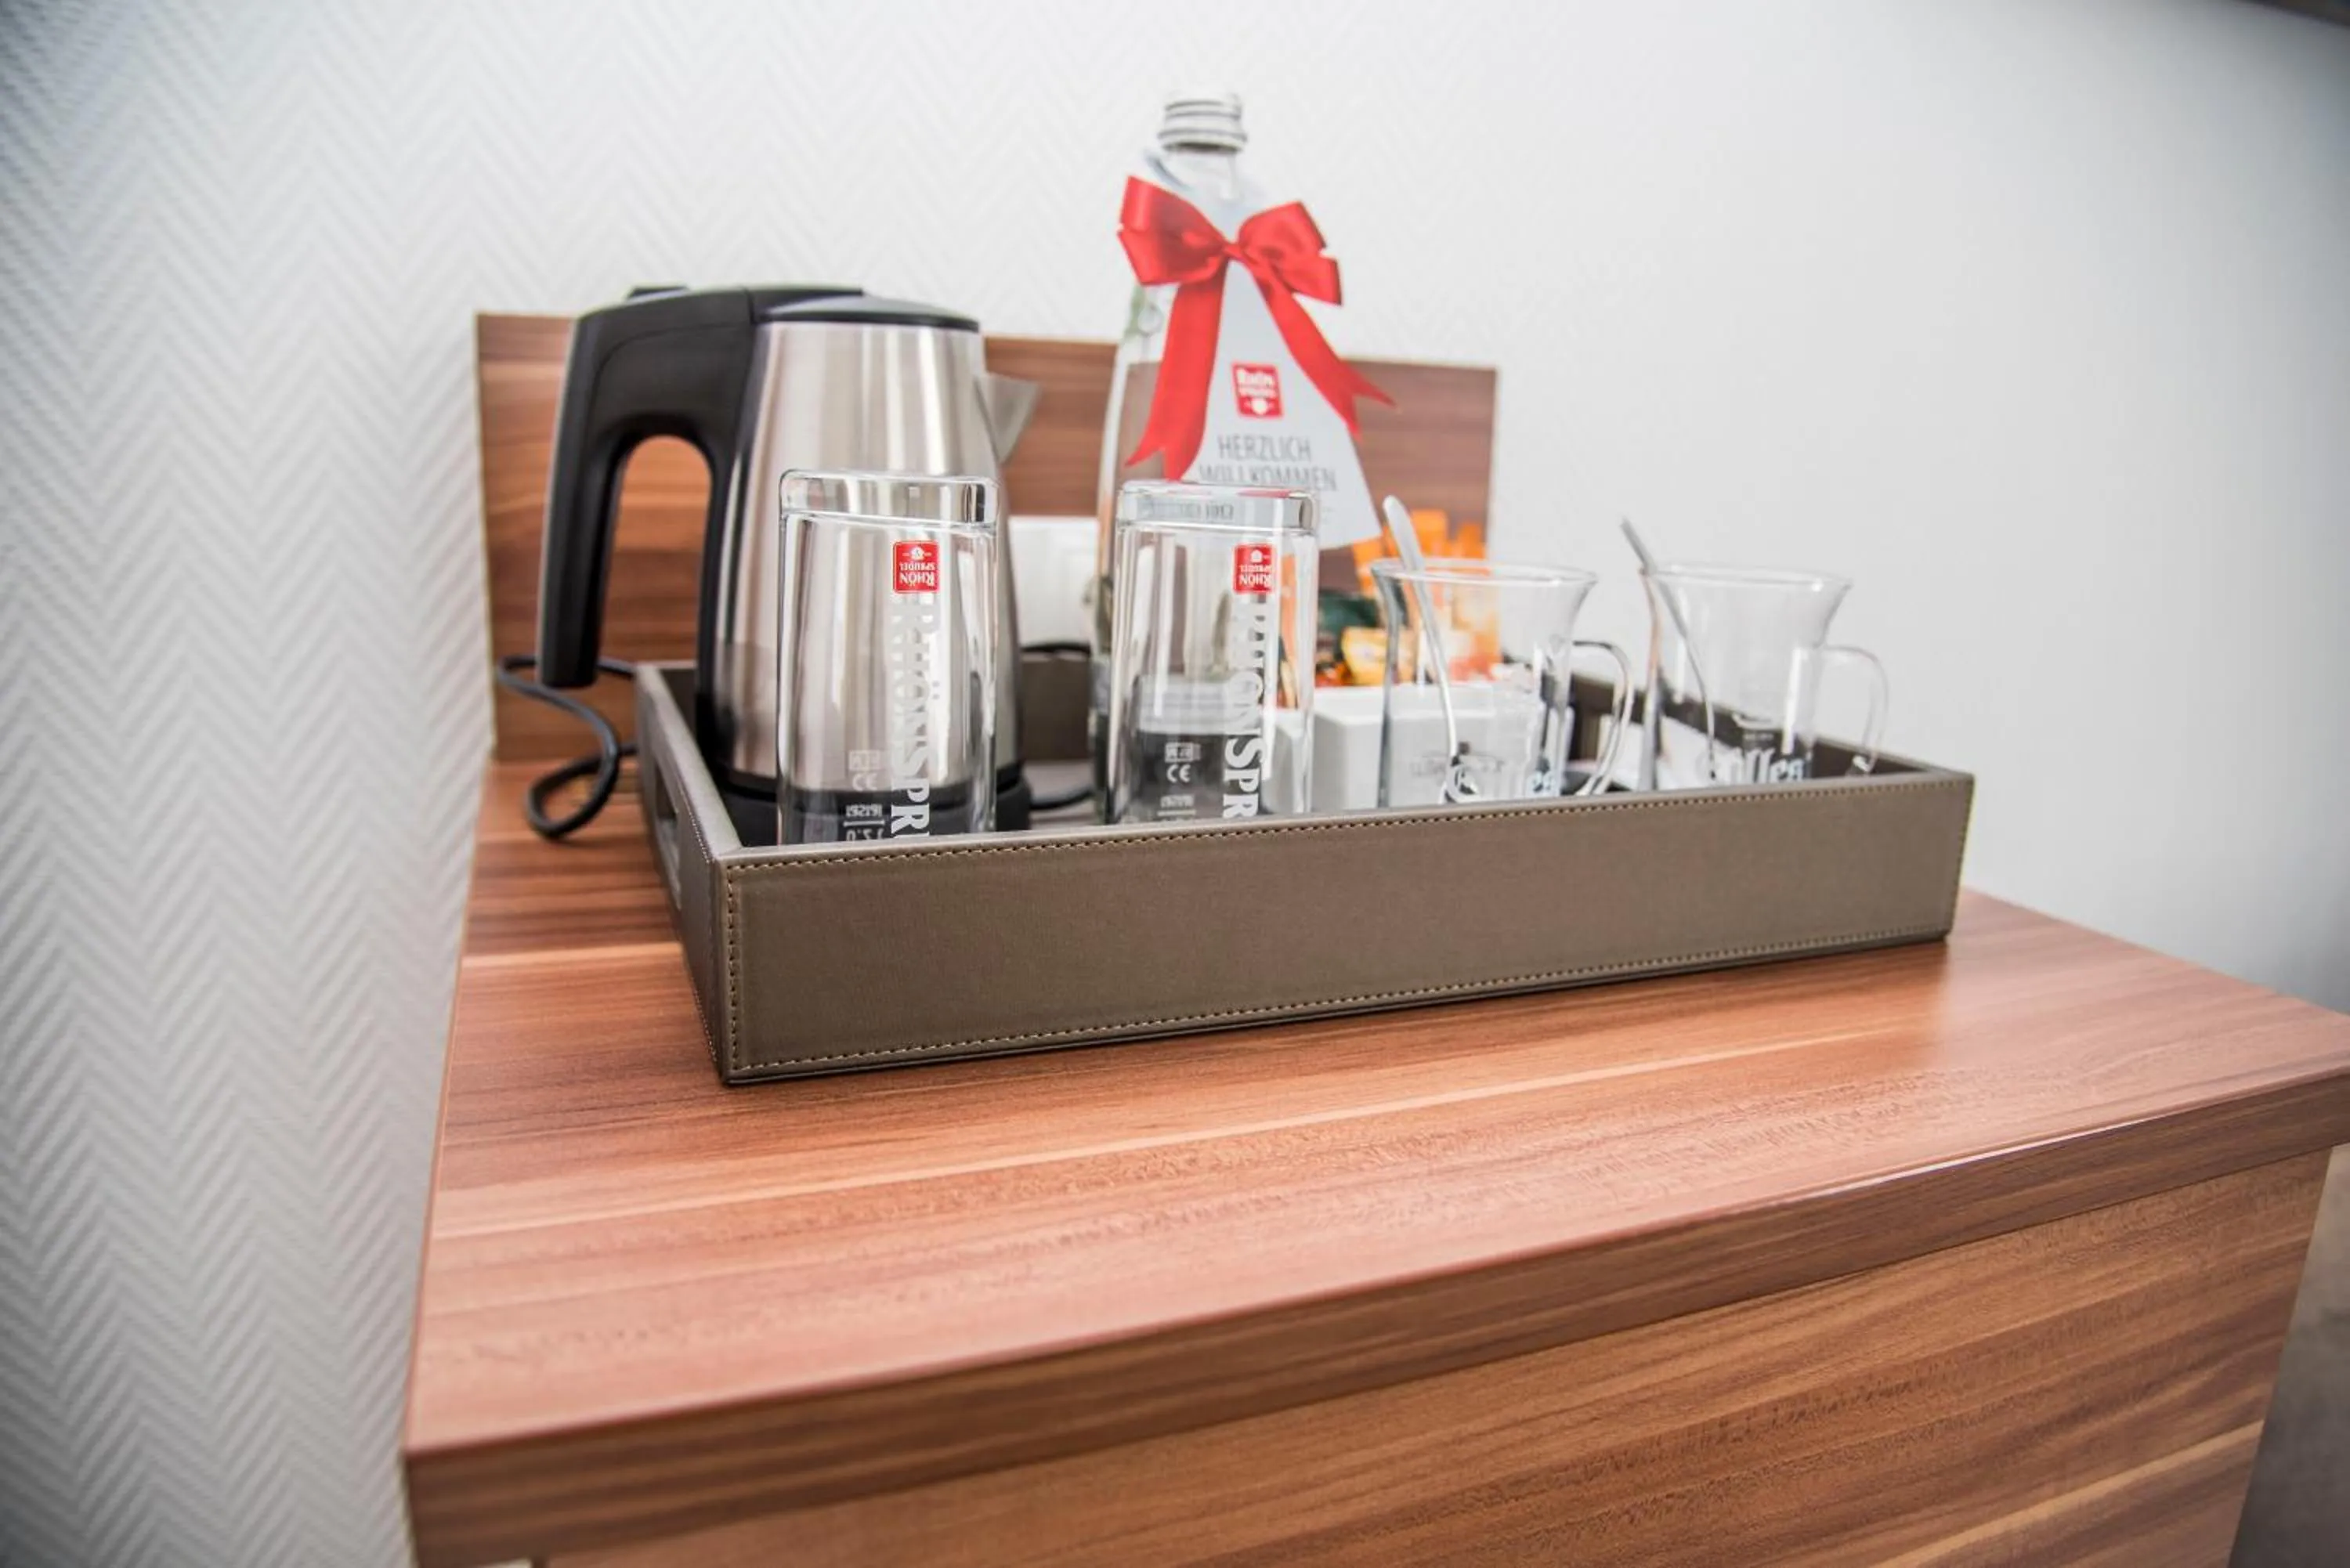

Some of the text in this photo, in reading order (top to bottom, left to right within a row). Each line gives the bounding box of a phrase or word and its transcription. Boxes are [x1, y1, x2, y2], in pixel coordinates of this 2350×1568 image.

[1218, 435, 1311, 461] HERZLICH
[1198, 464, 1337, 492] WILLKOMMEN
[1166, 764, 1191, 782] CE
